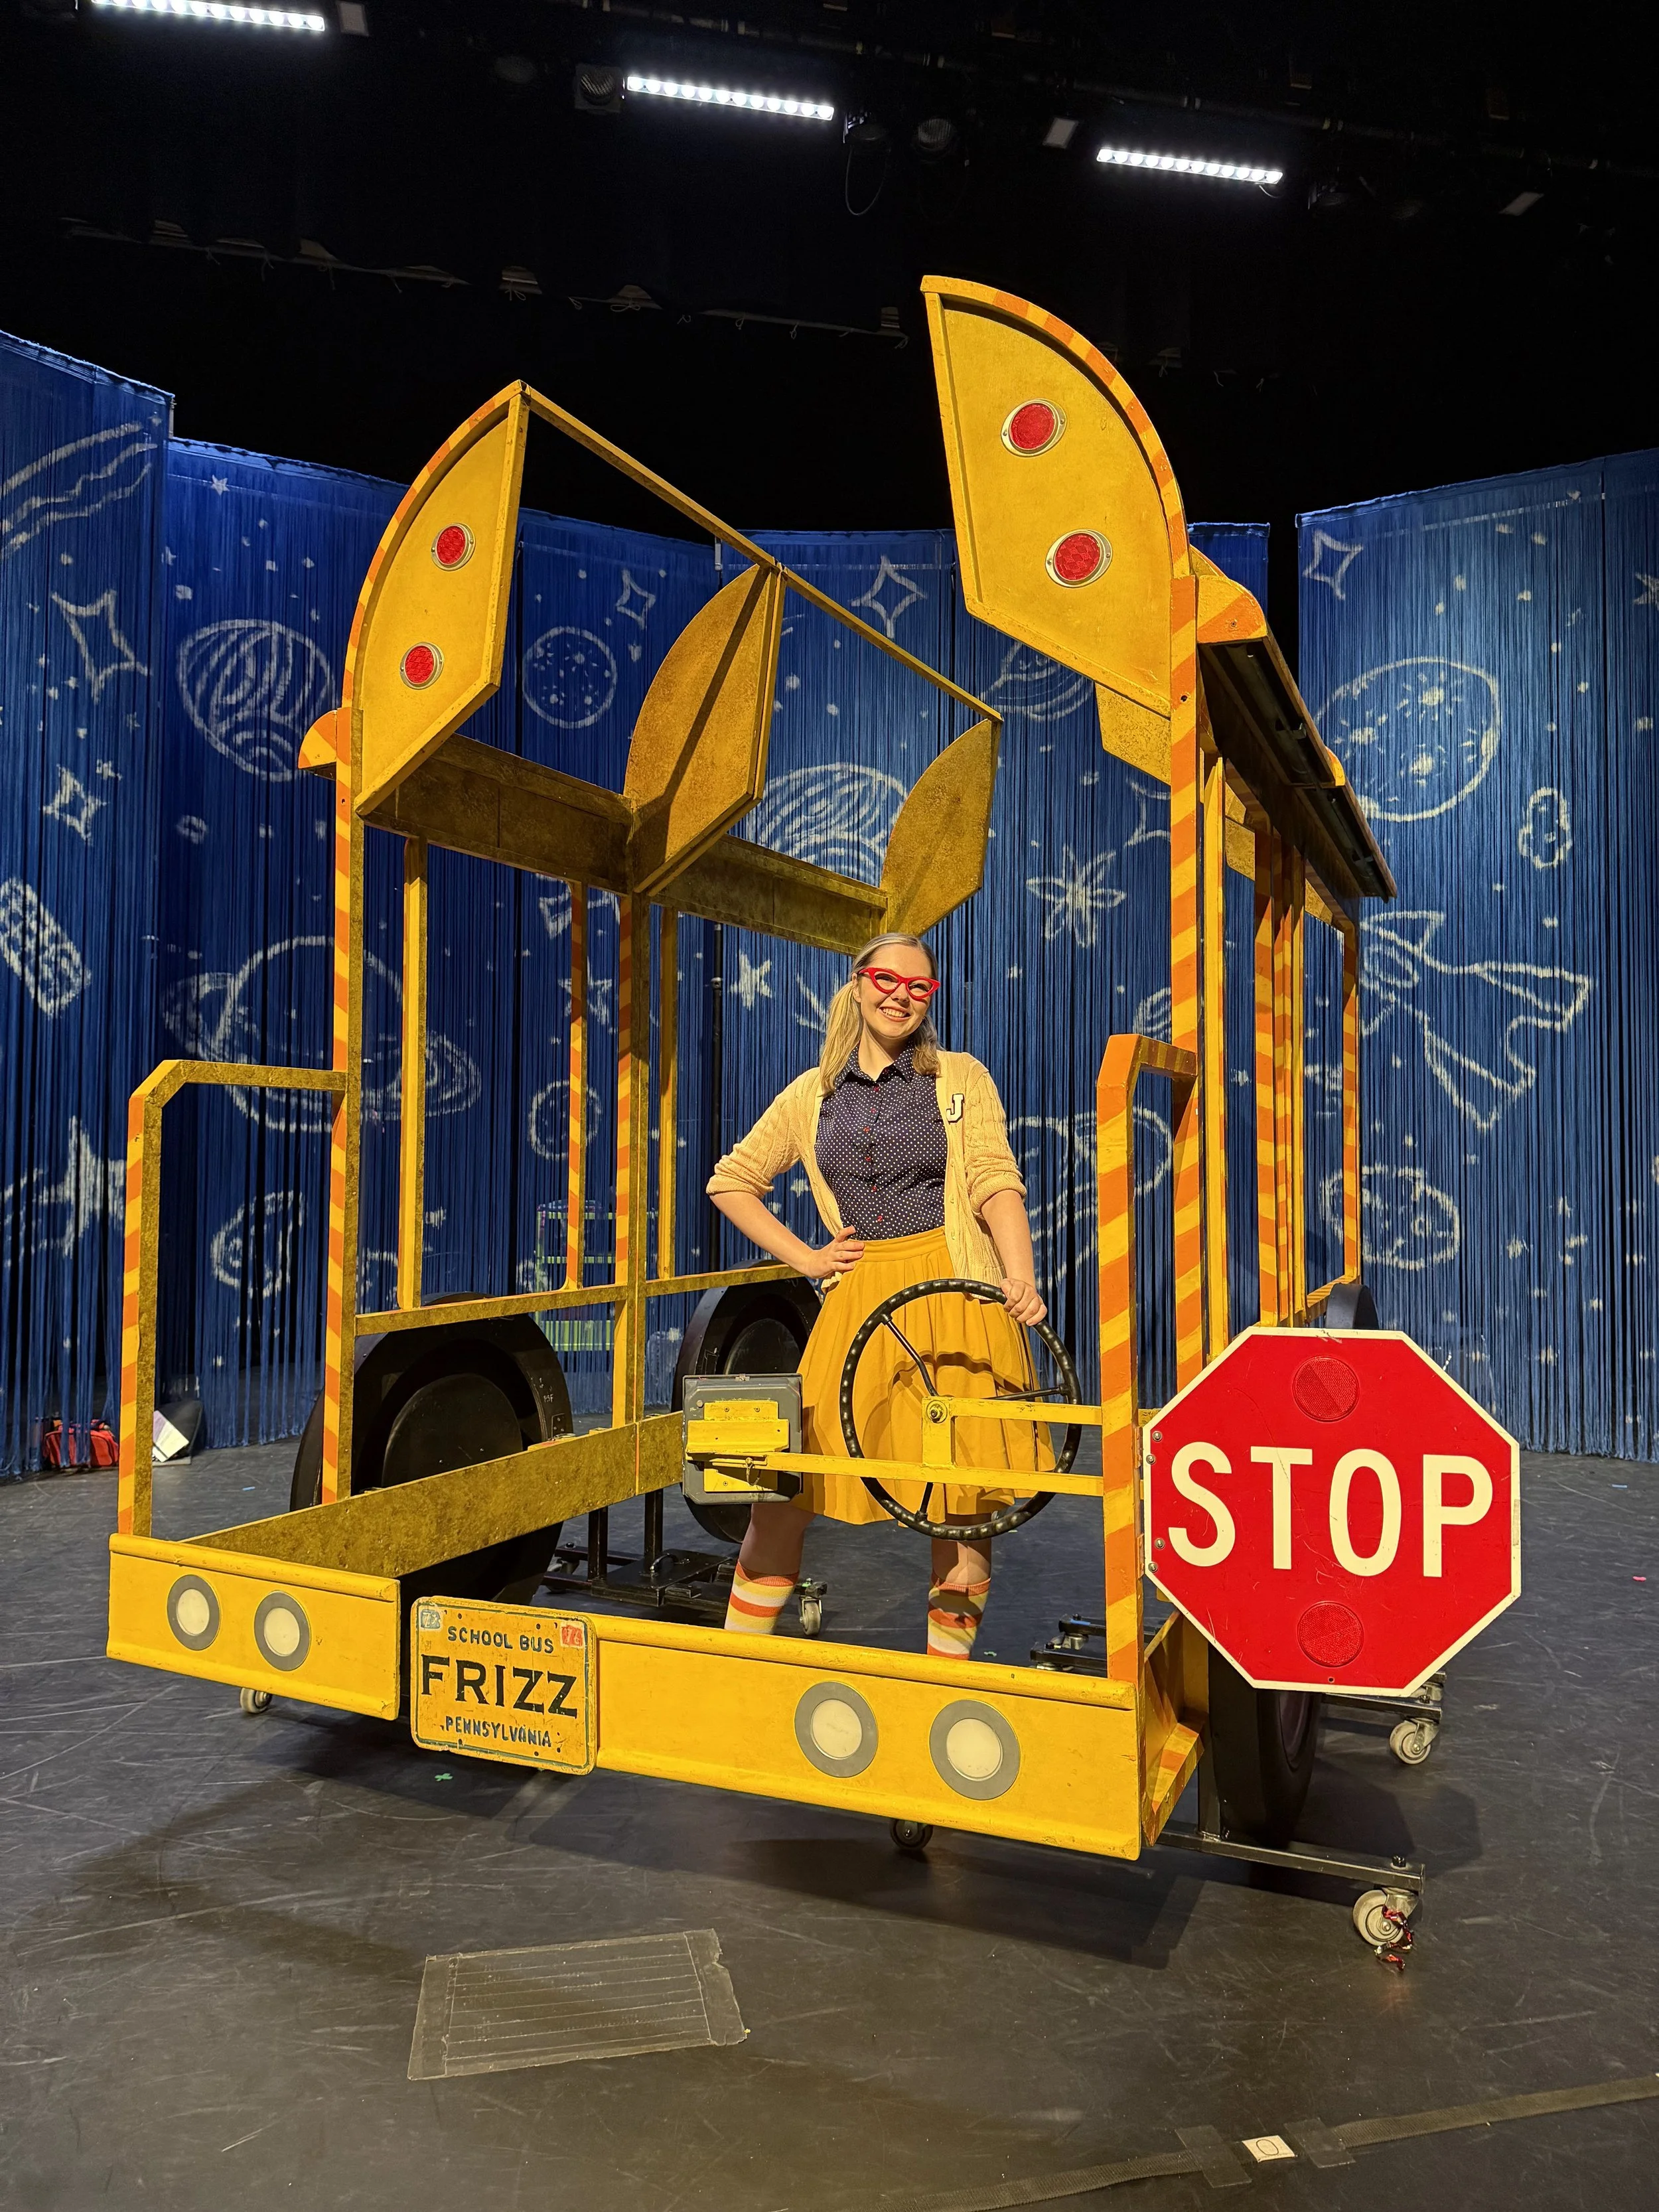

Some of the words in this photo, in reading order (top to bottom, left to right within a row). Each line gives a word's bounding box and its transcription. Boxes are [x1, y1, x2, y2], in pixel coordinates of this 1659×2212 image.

[946, 1093, 964, 1124] J
[1169, 1441, 1493, 1578] STOP
[447, 1626, 513, 1649] SCHOOL
[520, 1635, 553, 1653] BUS
[421, 1654, 577, 1719] FRIZZ
[445, 1716, 551, 1747] PENNSYLVANIA
